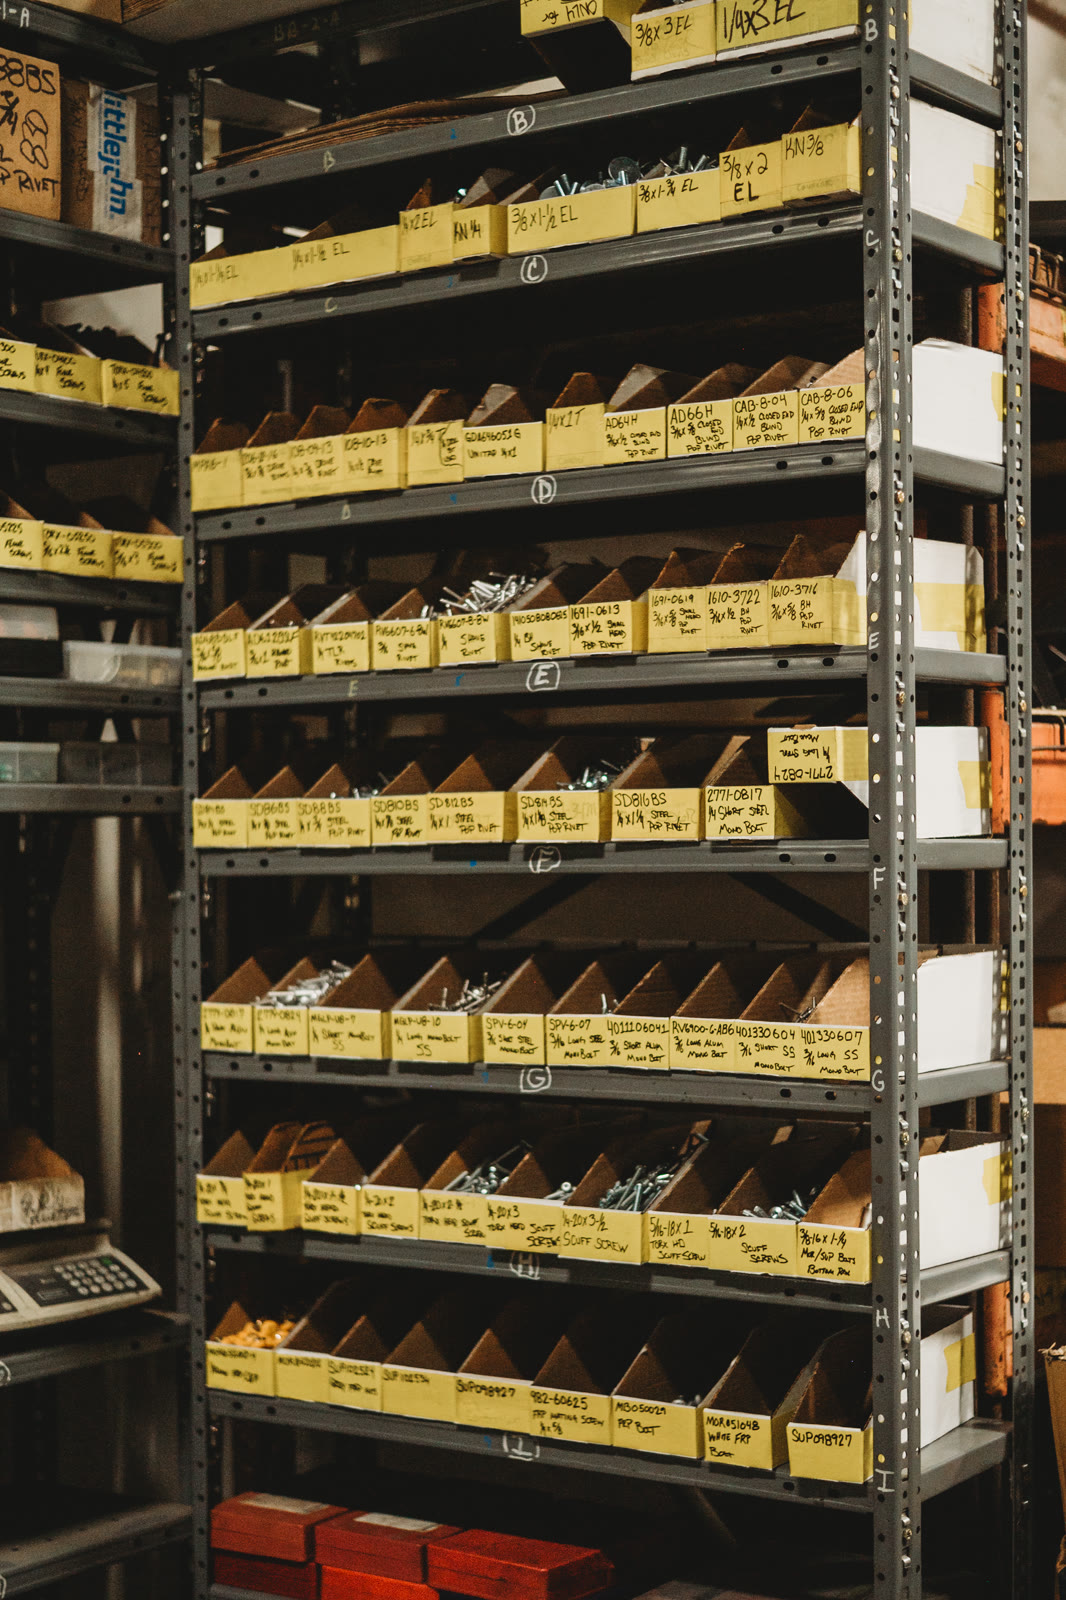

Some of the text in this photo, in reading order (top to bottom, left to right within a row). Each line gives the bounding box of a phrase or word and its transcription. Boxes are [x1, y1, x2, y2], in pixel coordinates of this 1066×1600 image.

[566, 0, 597, 21] ONLY
[865, 19, 878, 41] B
[13, 170, 59, 198] RIVET
[681, 178, 699, 193] EL
[733, 181, 760, 202] EL
[561, 205, 578, 221] EL
[866, 229, 880, 247] C
[801, 386, 853, 406] CAB-8-06
[734, 394, 787, 414] CAB-8-04
[828, 403, 848, 414] CLOSED
[605, 414, 638, 431] AD64H
[758, 411, 780, 421] CLOSED
[829, 415, 852, 425] BLIND
[760, 421, 782, 432] BLIND
[808, 427, 825, 438] POP
[746, 435, 761, 445] POP
[686, 444, 701, 453] POP
[708, 590, 760, 605] 1610-3722
[771, 584, 817, 599] 1610-3716
[652, 594, 694, 607] 1691-0619
[571, 604, 620, 620] 1691-0613
[582, 640, 596, 650] POP
[868, 632, 879, 650] E
[774, 765, 833, 781] 2771-0824
[707, 788, 762, 802] 2771-0817
[719, 806, 744, 820] SHORT
[873, 866, 886, 890] F
[486, 1018, 528, 1030] SPV-6-04
[550, 1018, 591, 1031] SPV-6-07
[607, 1020, 669, 1036] 4011106041
[735, 1024, 795, 1039] 401330604
[801, 1030, 863, 1045] 401330607
[416, 1044, 432, 1056] SS
[783, 1045, 795, 1058] SS
[844, 1049, 859, 1060] SS
[872, 1069, 885, 1092] G
[562, 1231, 629, 1253] SCUFF SCREW
[750, 1254, 788, 1263] SCREWS
[875, 1308, 890, 1328] H
[456, 1379, 516, 1397] SUP098927
[530, 1390, 588, 1410] 982-60625
[735, 1433, 751, 1444] FRP
[791, 1428, 852, 1447] SUP098927
[875, 1468, 895, 1492] I
